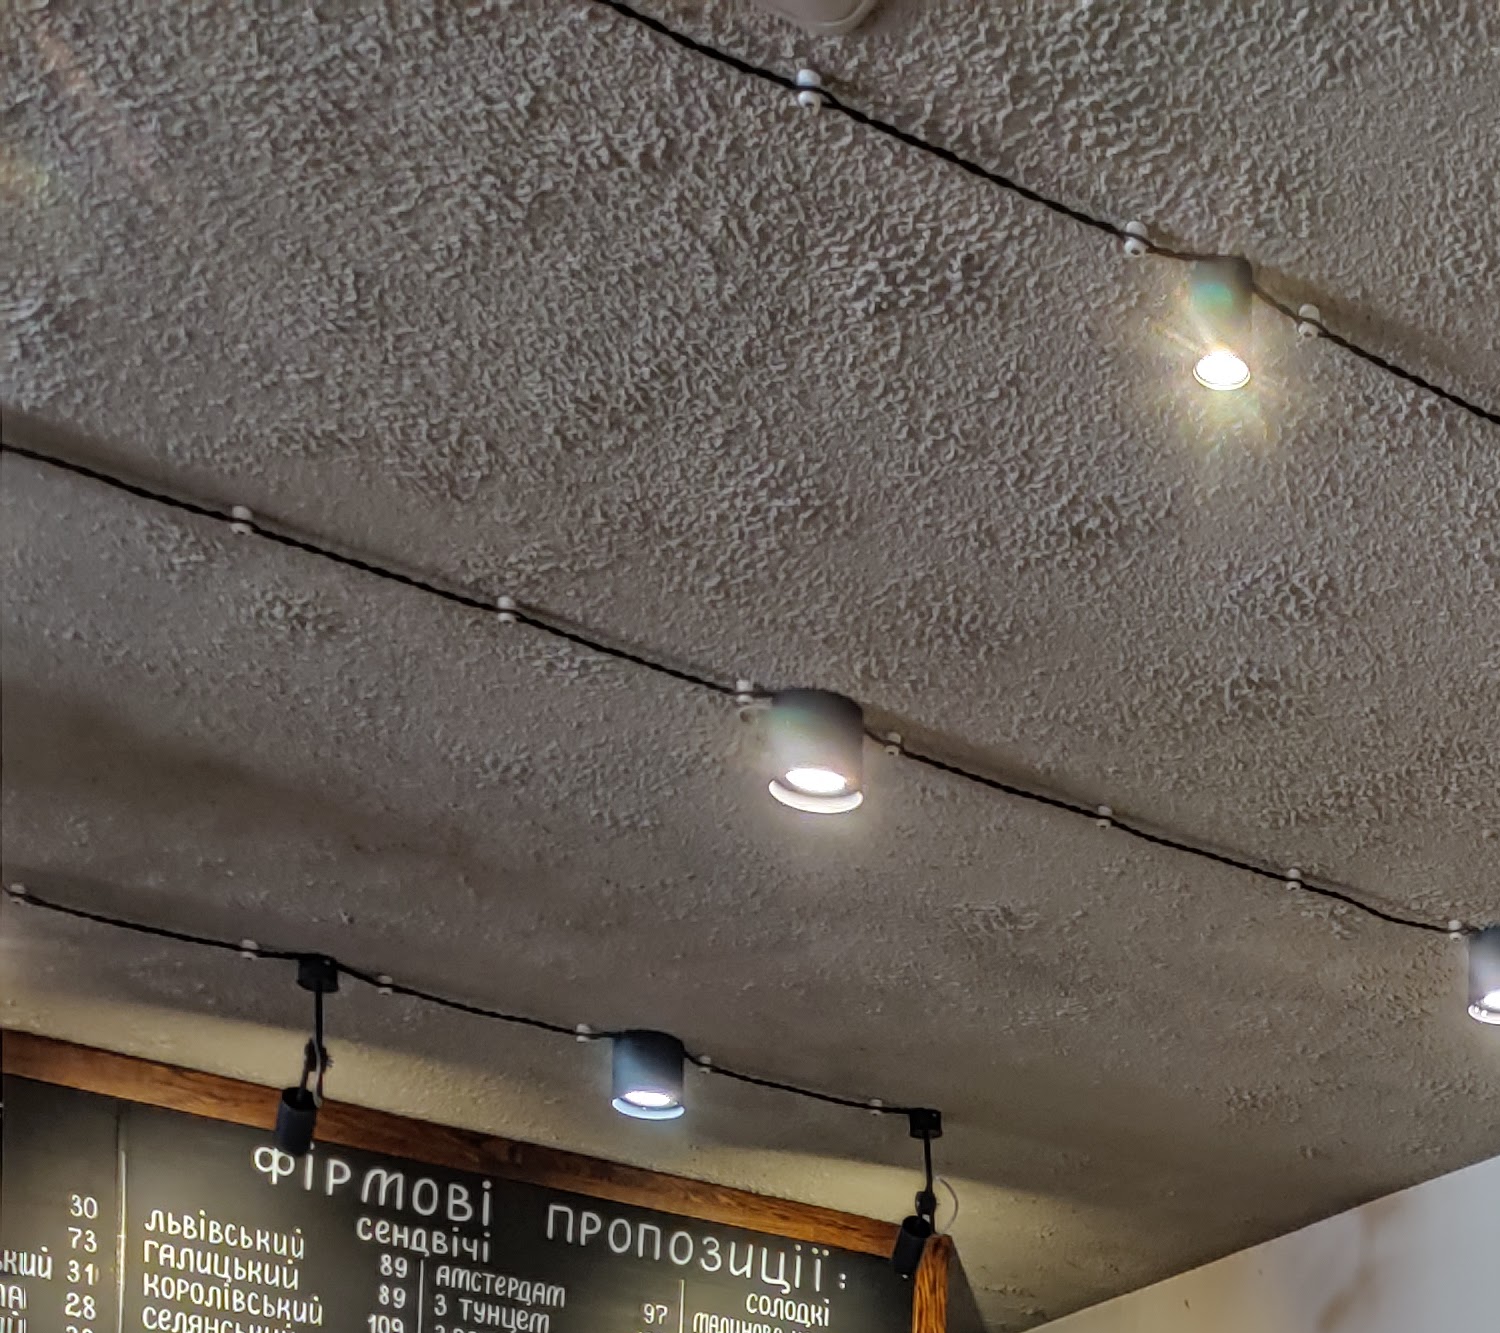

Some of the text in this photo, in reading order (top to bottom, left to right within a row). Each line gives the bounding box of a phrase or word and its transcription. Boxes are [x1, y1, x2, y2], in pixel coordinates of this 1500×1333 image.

[69, 1194, 99, 1219] 30
[67, 1227, 97, 1253] 73
[66, 1260, 95, 1286] 31
[380, 1253, 408, 1279] 89
[65, 1292, 96, 1320] 28
[378, 1284, 407, 1309] 89
[643, 1302, 669, 1326] 97
